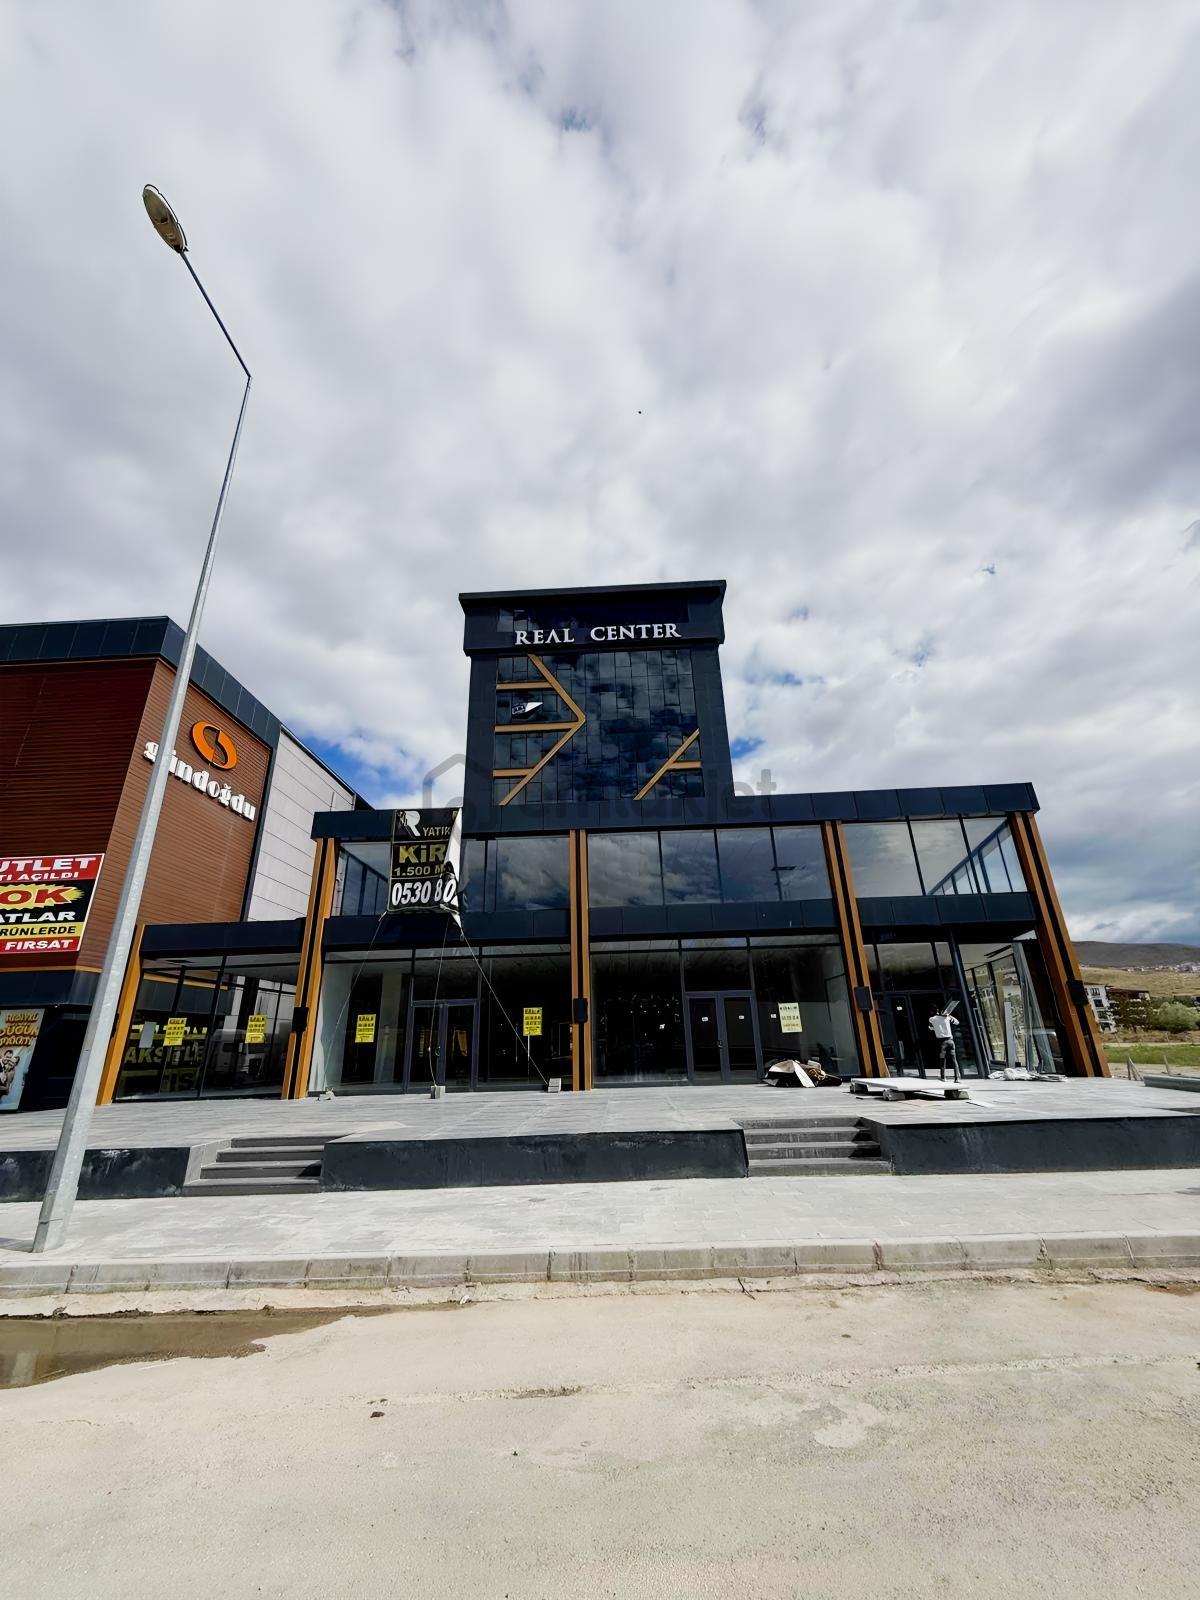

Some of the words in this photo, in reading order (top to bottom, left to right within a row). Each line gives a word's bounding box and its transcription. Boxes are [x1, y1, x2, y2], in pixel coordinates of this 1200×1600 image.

[514, 628, 575, 646] REAL
[590, 622, 682, 642] CENTER
[17, 871, 80, 882] AÇILDI
[393, 866, 431, 877] 1.500
[391, 881, 432, 906] 0530
[5, 939, 74, 951] FIRSAT
